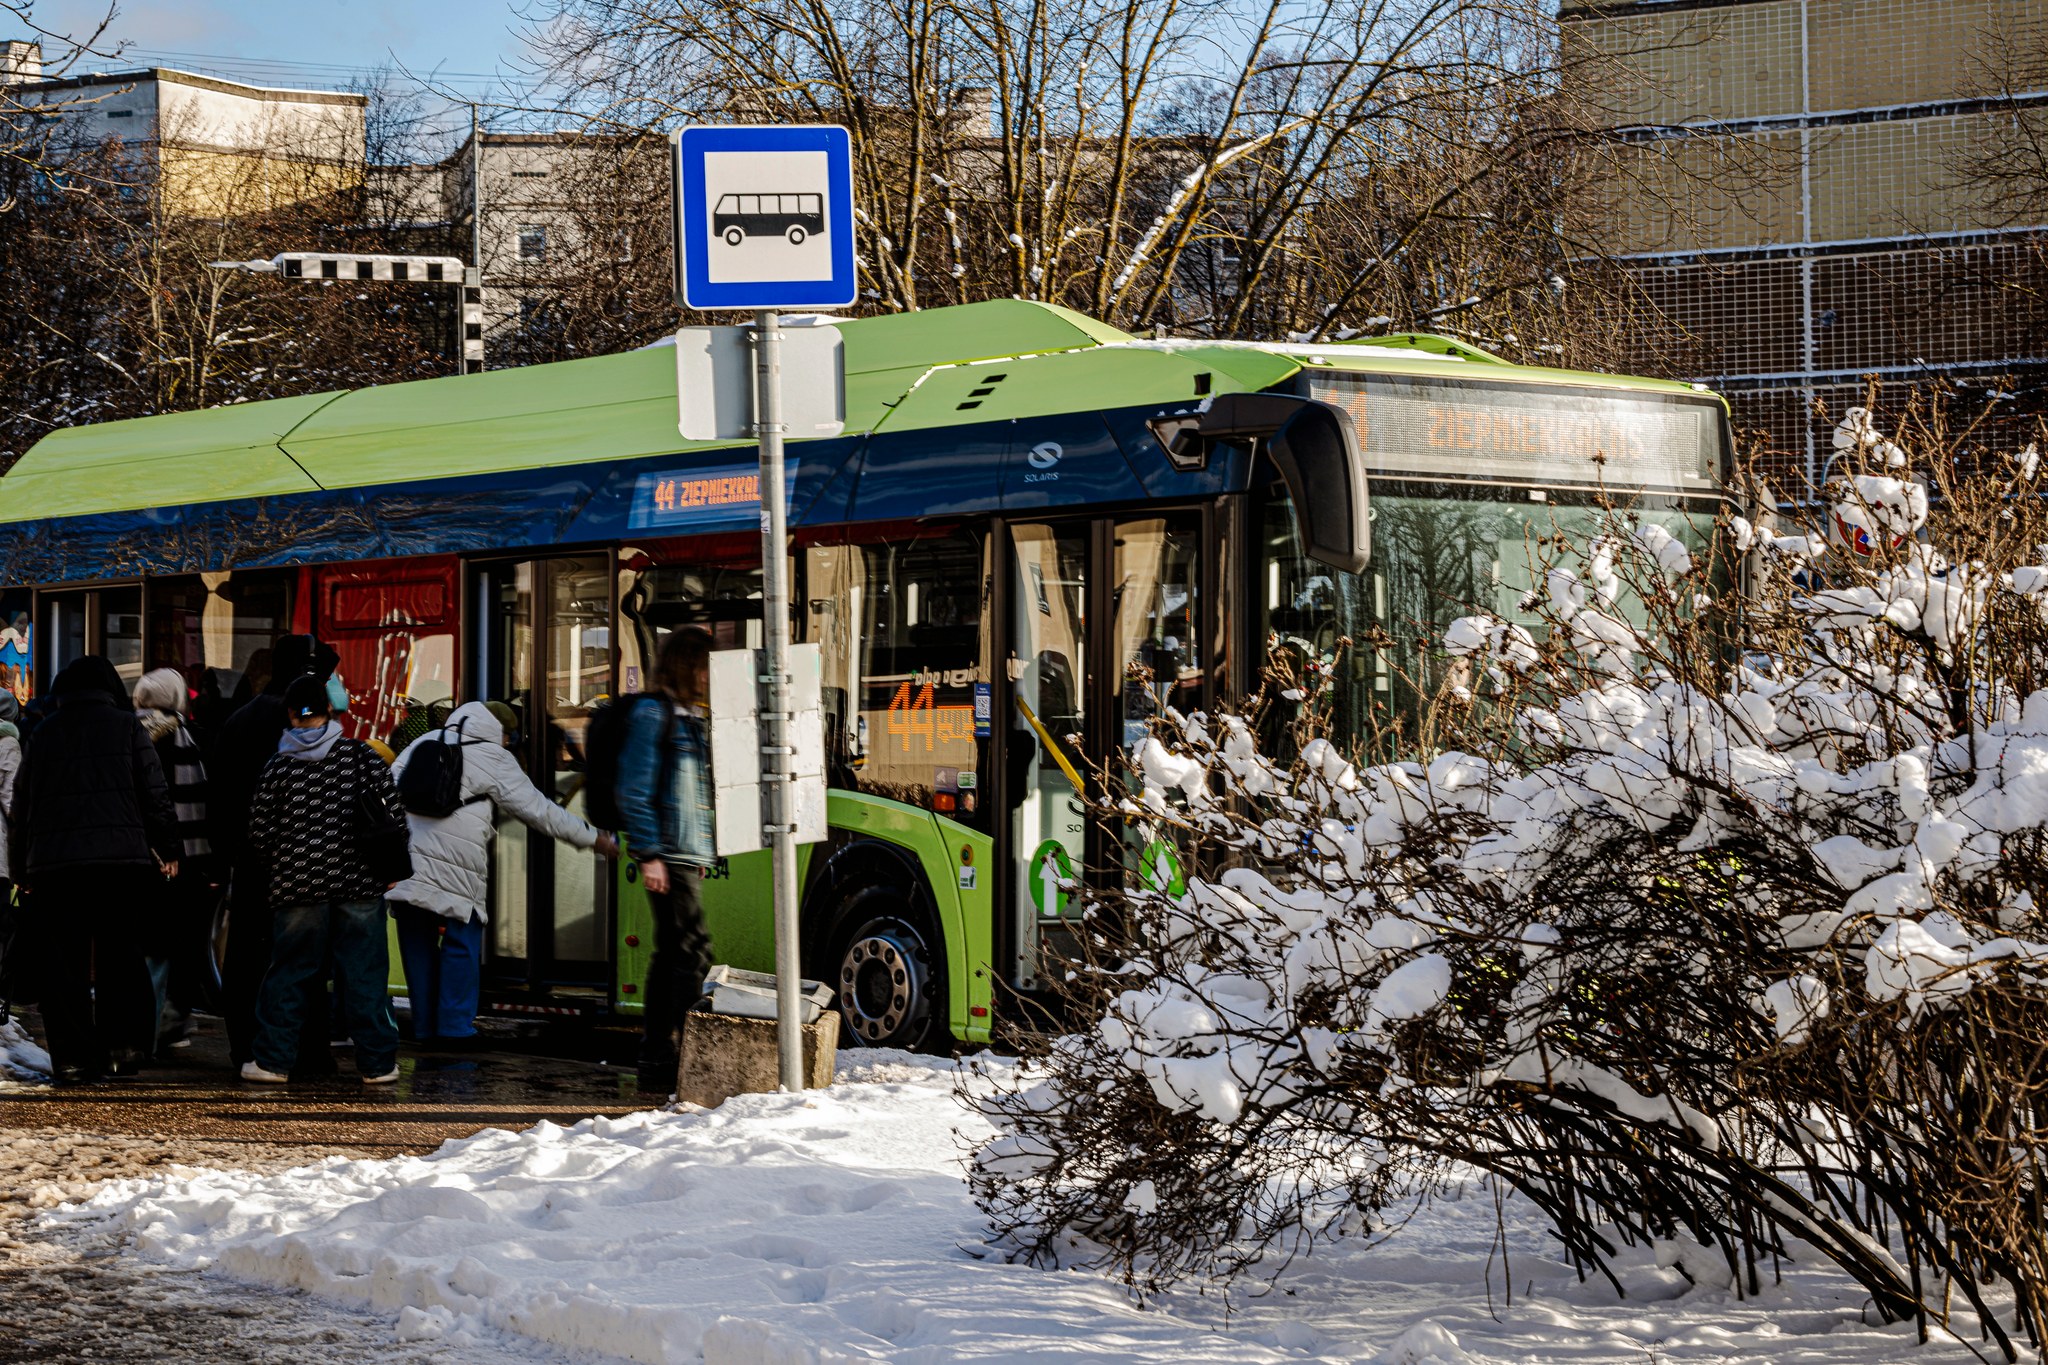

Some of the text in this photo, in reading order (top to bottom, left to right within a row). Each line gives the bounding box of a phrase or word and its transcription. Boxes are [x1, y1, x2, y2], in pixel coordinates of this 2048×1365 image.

[1024, 472, 1059, 483] SOLARIS
[655, 481, 677, 510] 44
[888, 682, 933, 751] 44
